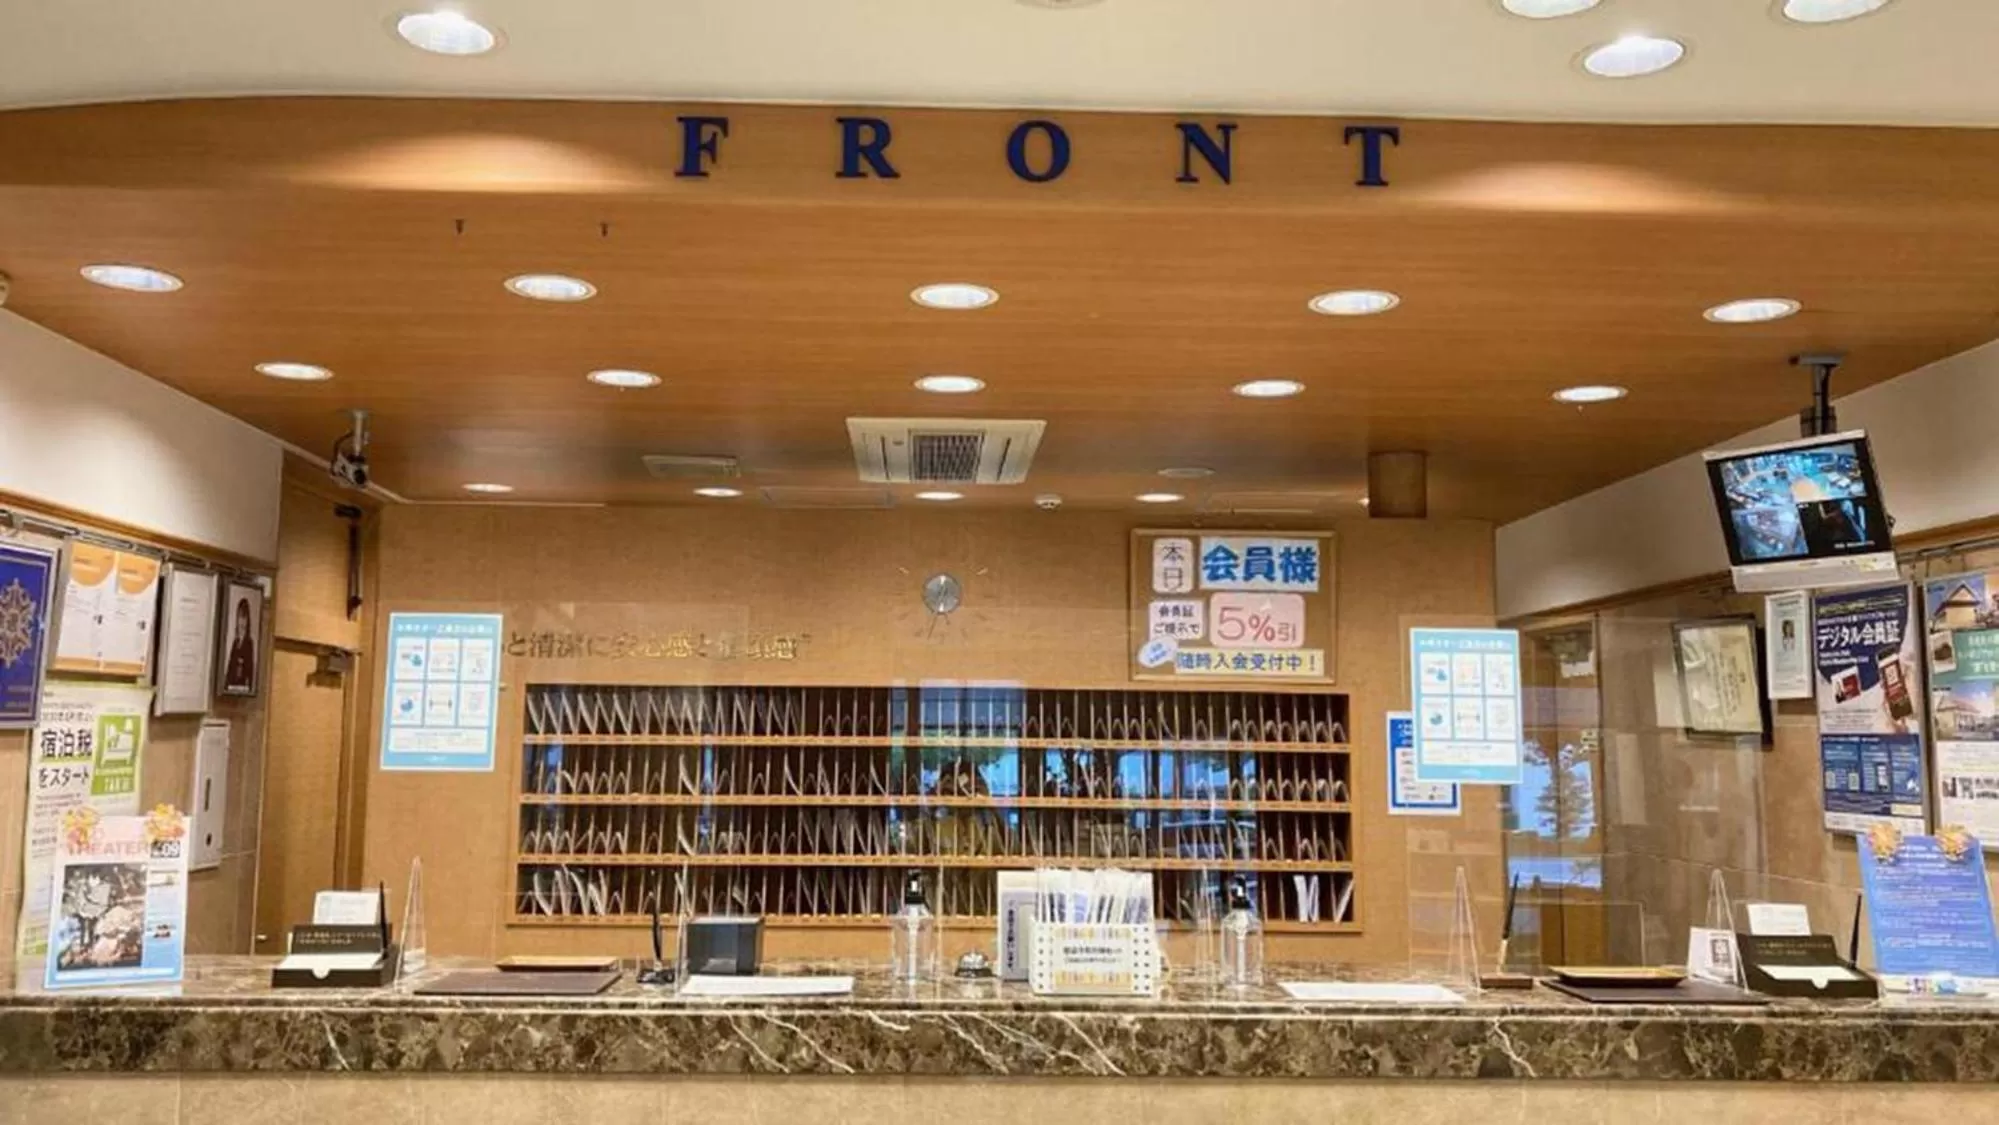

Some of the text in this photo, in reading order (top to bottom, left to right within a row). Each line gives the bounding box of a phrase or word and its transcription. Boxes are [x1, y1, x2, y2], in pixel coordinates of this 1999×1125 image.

[675, 116, 1400, 187] FRONT
[1162, 543, 1184, 590] 本日
[1202, 543, 1317, 584] 会員様
[1217, 606, 1297, 642] 5%引
[1817, 620, 1901, 649] デジタル会員証
[41, 728, 92, 758] 宿泊税
[38, 766, 89, 789] をスタート
